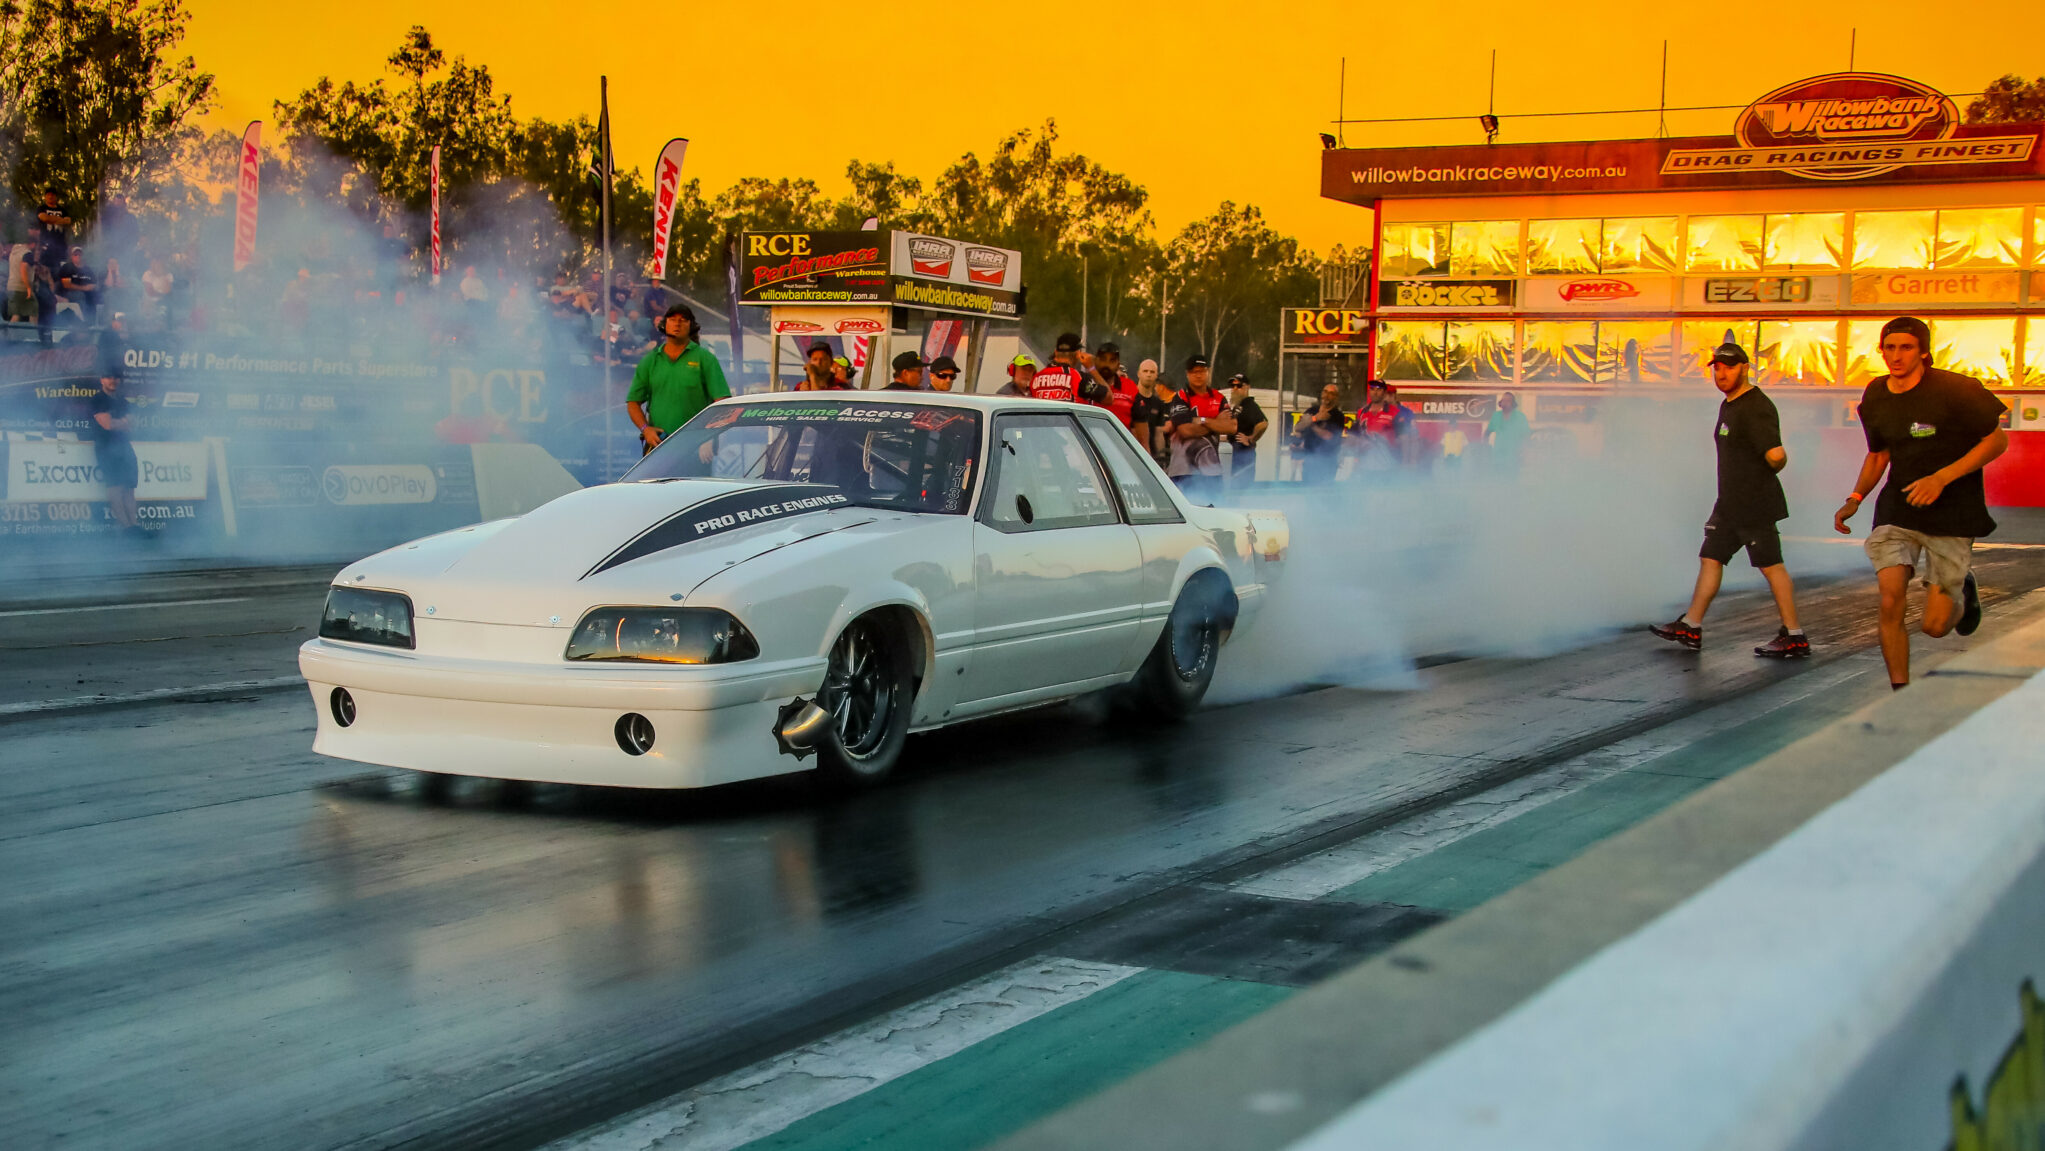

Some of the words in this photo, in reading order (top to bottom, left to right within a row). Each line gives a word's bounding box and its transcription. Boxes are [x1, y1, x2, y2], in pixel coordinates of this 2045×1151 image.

[1754, 95, 1945, 133] Willowbank
[1808, 112, 1920, 138] Raceway
[1673, 153, 1753, 168] DRAG
[1766, 148, 1904, 164] RACINGS
[1916, 142, 2024, 158] FINEST
[1351, 164, 1627, 184] willowbankraceway.com.au
[654, 156, 679, 274] KENDA
[748, 234, 812, 256] RCE
[913, 241, 950, 255] IHRA
[753, 248, 879, 287] Performance
[969, 250, 1004, 264] IHRA
[835, 269, 887, 278] Warehouse
[1888, 274, 1981, 295] Garrett
[760, 289, 878, 302] willowbankraceway.com.au
[895, 280, 1016, 314] willowbankraceway.com.au
[124, 349, 174, 368] QLD's
[178, 351, 198, 369] #1
[205, 353, 308, 373] Performance
[312, 357, 351, 376] Parts
[358, 358, 438, 380] Superstore
[35, 384, 100, 400] Warehou
[1032, 373, 1072, 390] OFFICIAL
[1423, 402, 1465, 414] CRANES
[56, 420, 74, 429] QLD
[142, 460, 193, 483] Parts
[48, 503, 91, 521] 0800
[694, 514, 736, 535] PRO
[736, 504, 783, 523] RACE
[782, 494, 848, 513] ENGINES
